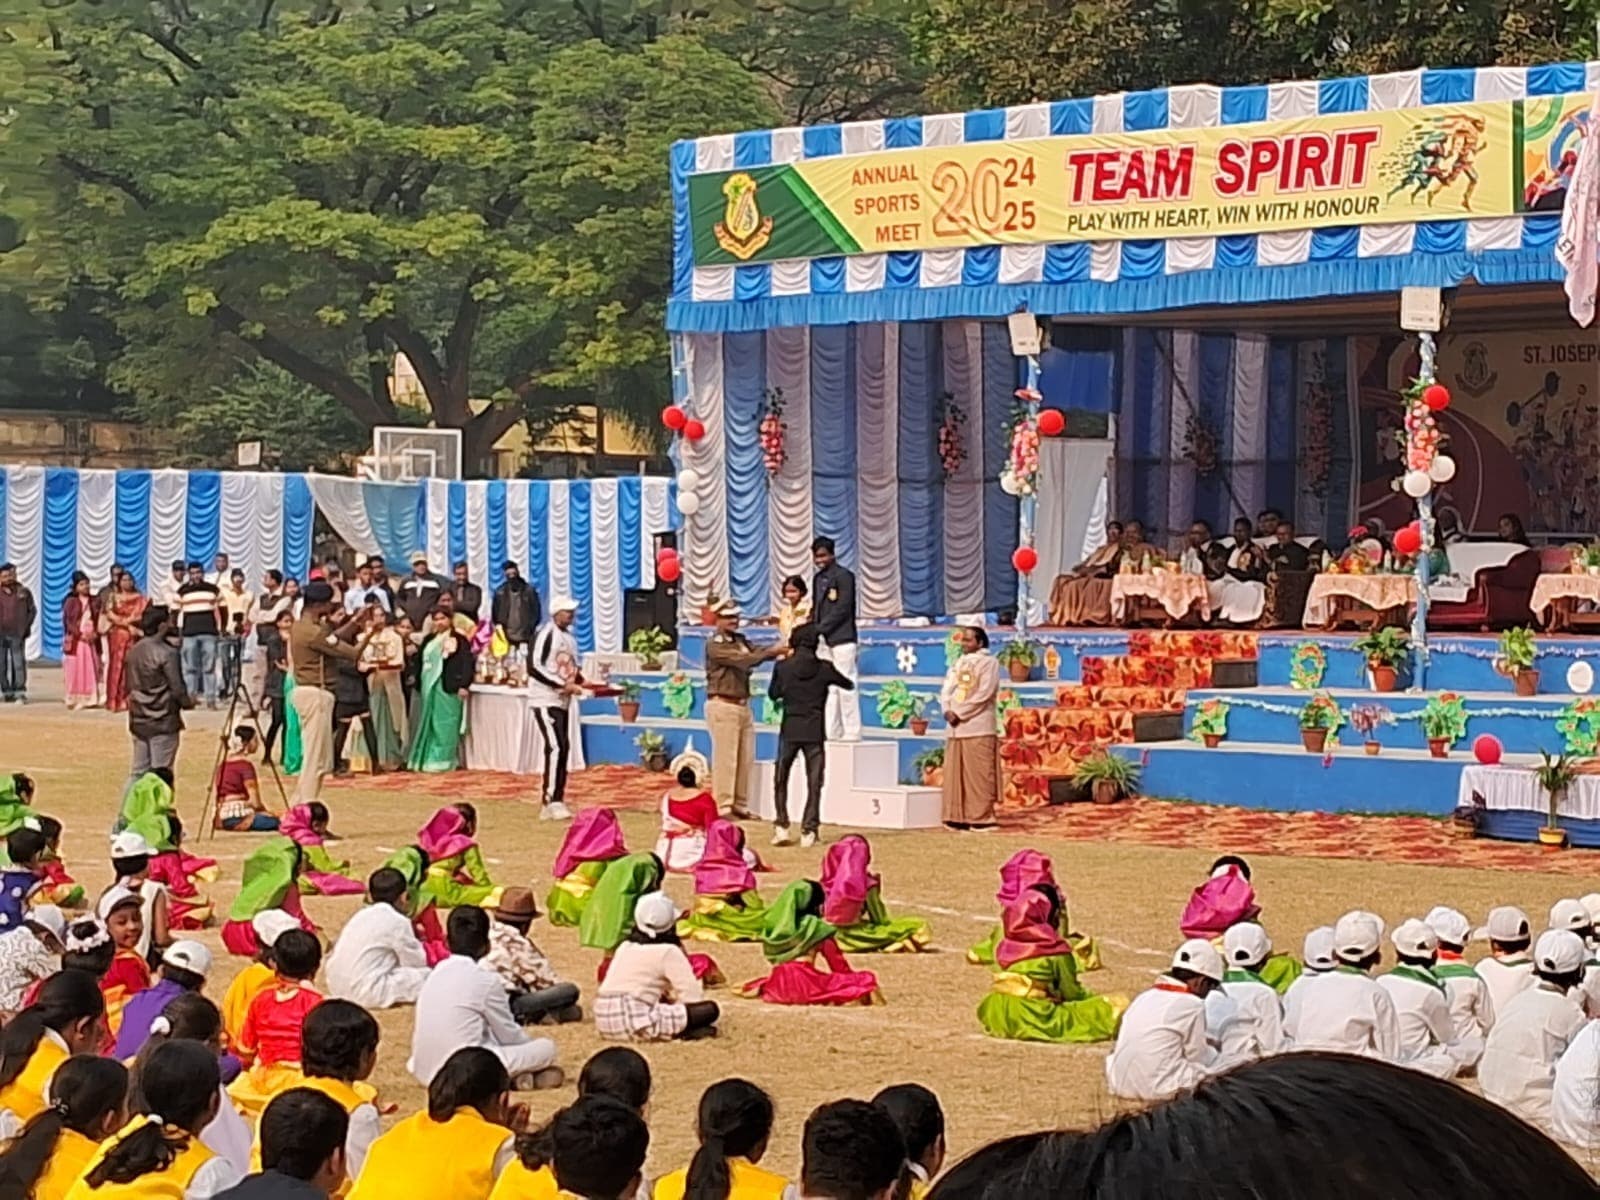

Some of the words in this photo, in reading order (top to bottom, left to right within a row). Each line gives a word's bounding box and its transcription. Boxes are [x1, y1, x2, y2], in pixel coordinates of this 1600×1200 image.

[851, 164, 919, 186] ANNUAL
[1003, 156, 1036, 187] 24
[1067, 145, 1195, 203] TEAM
[1213, 130, 1379, 195] SPIRIT
[854, 193, 920, 216] SPORTS
[1003, 200, 1036, 231] 25
[1067, 212, 1106, 232] PLAY
[1109, 209, 1150, 229] WITH
[1154, 207, 1211, 229] HEART,
[1216, 204, 1250, 225] WIN
[1255, 201, 1299, 222] WITH
[1303, 196, 1380, 219] HONOUR
[875, 223, 921, 243] MEET
[1523, 345, 1544, 364] ST.
[1549, 343, 1600, 363] JOSEP
[871, 798, 881, 815] 3
